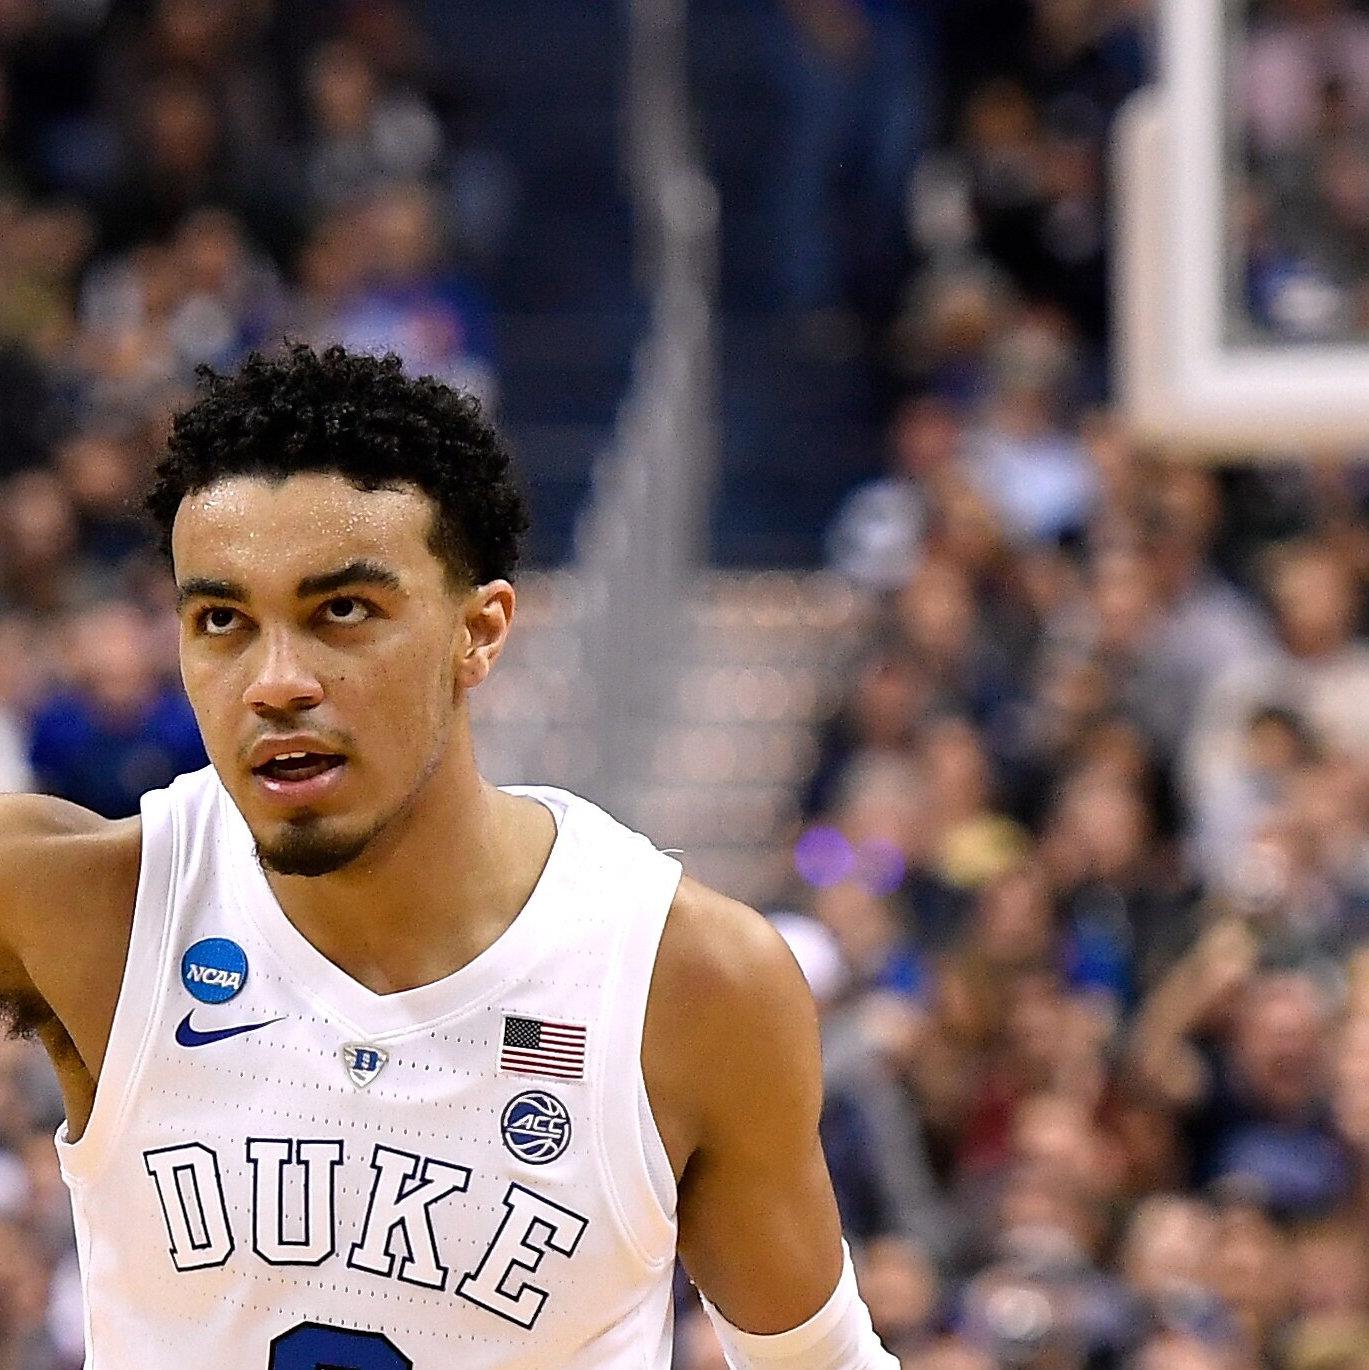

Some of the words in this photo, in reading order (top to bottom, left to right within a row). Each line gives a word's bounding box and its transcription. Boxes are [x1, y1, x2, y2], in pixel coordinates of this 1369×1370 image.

[186, 963, 242, 990] NCAA
[511, 1113, 567, 1135] ACC
[143, 1138, 589, 1330] DUKE
